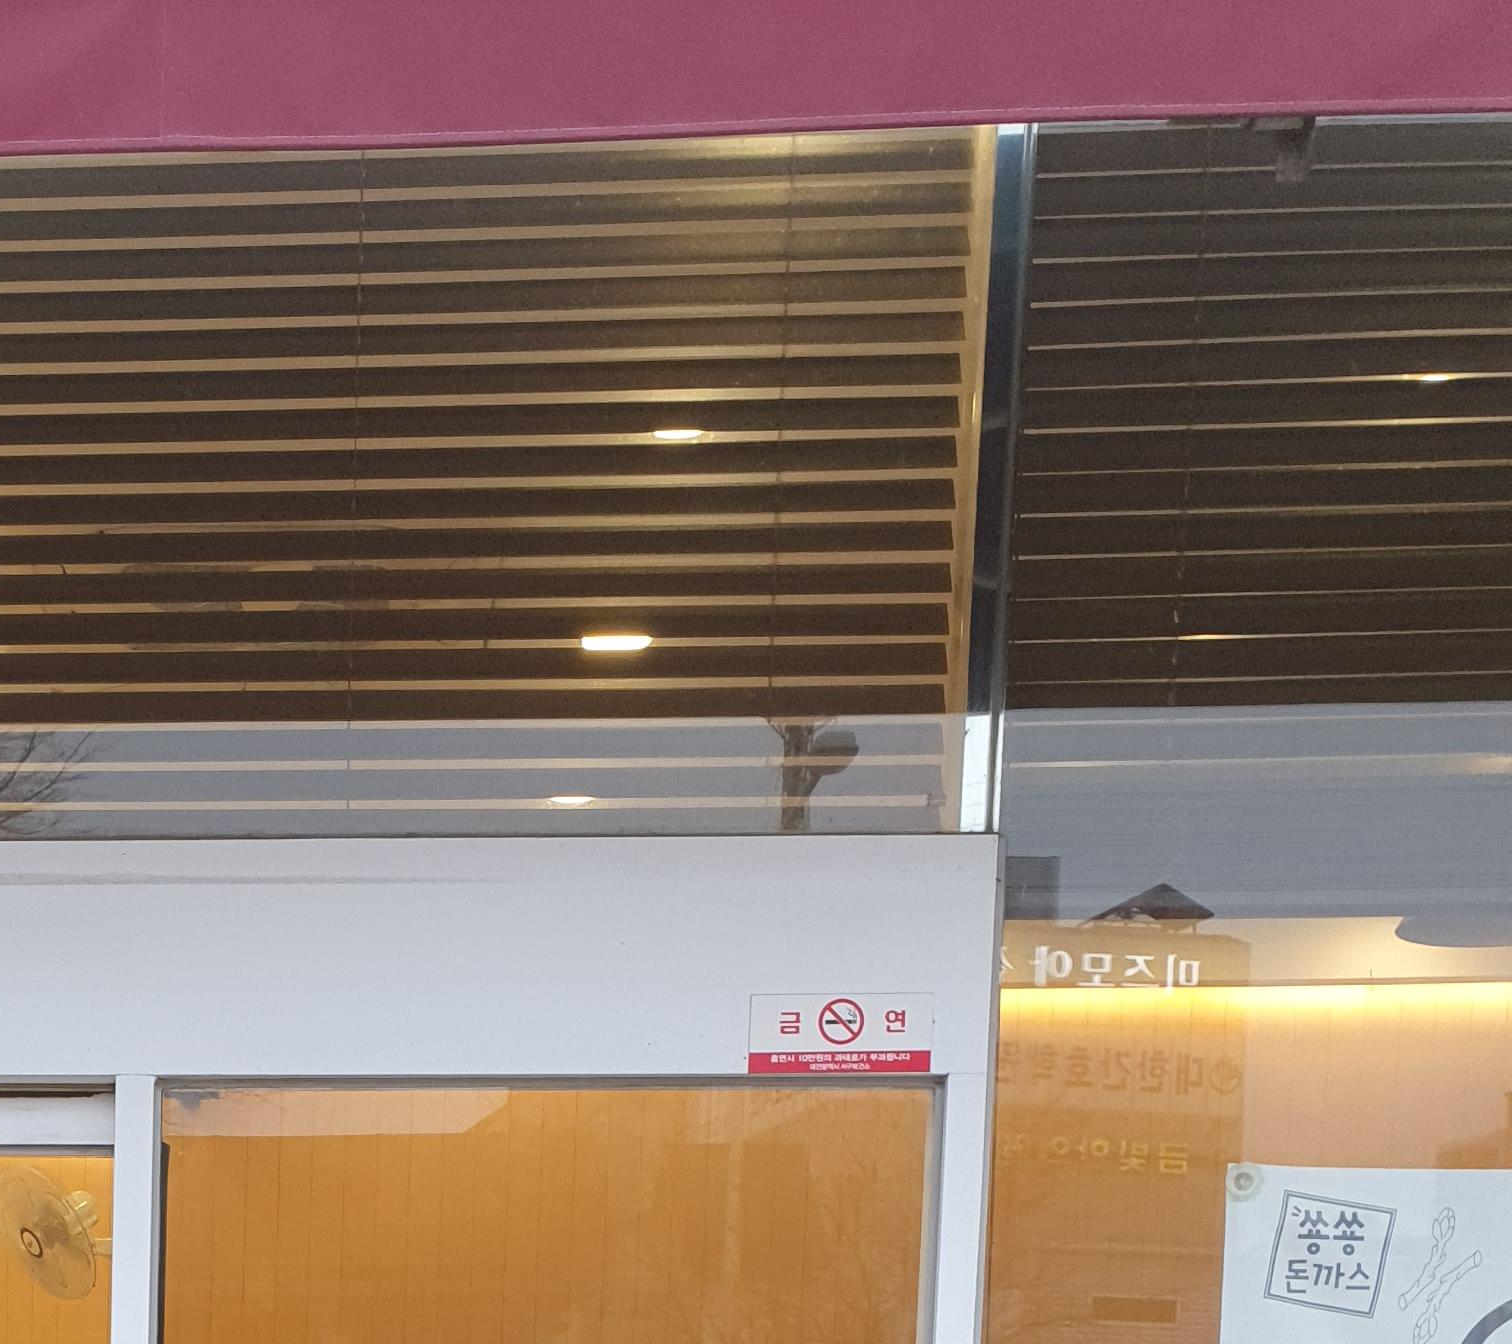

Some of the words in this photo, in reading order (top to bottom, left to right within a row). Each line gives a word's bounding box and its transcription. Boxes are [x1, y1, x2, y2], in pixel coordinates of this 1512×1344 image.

[779, 1011, 801, 1034] 금
[884, 1010, 906, 1034] 연
[1285, 1259, 1371, 1294] 돈까스
